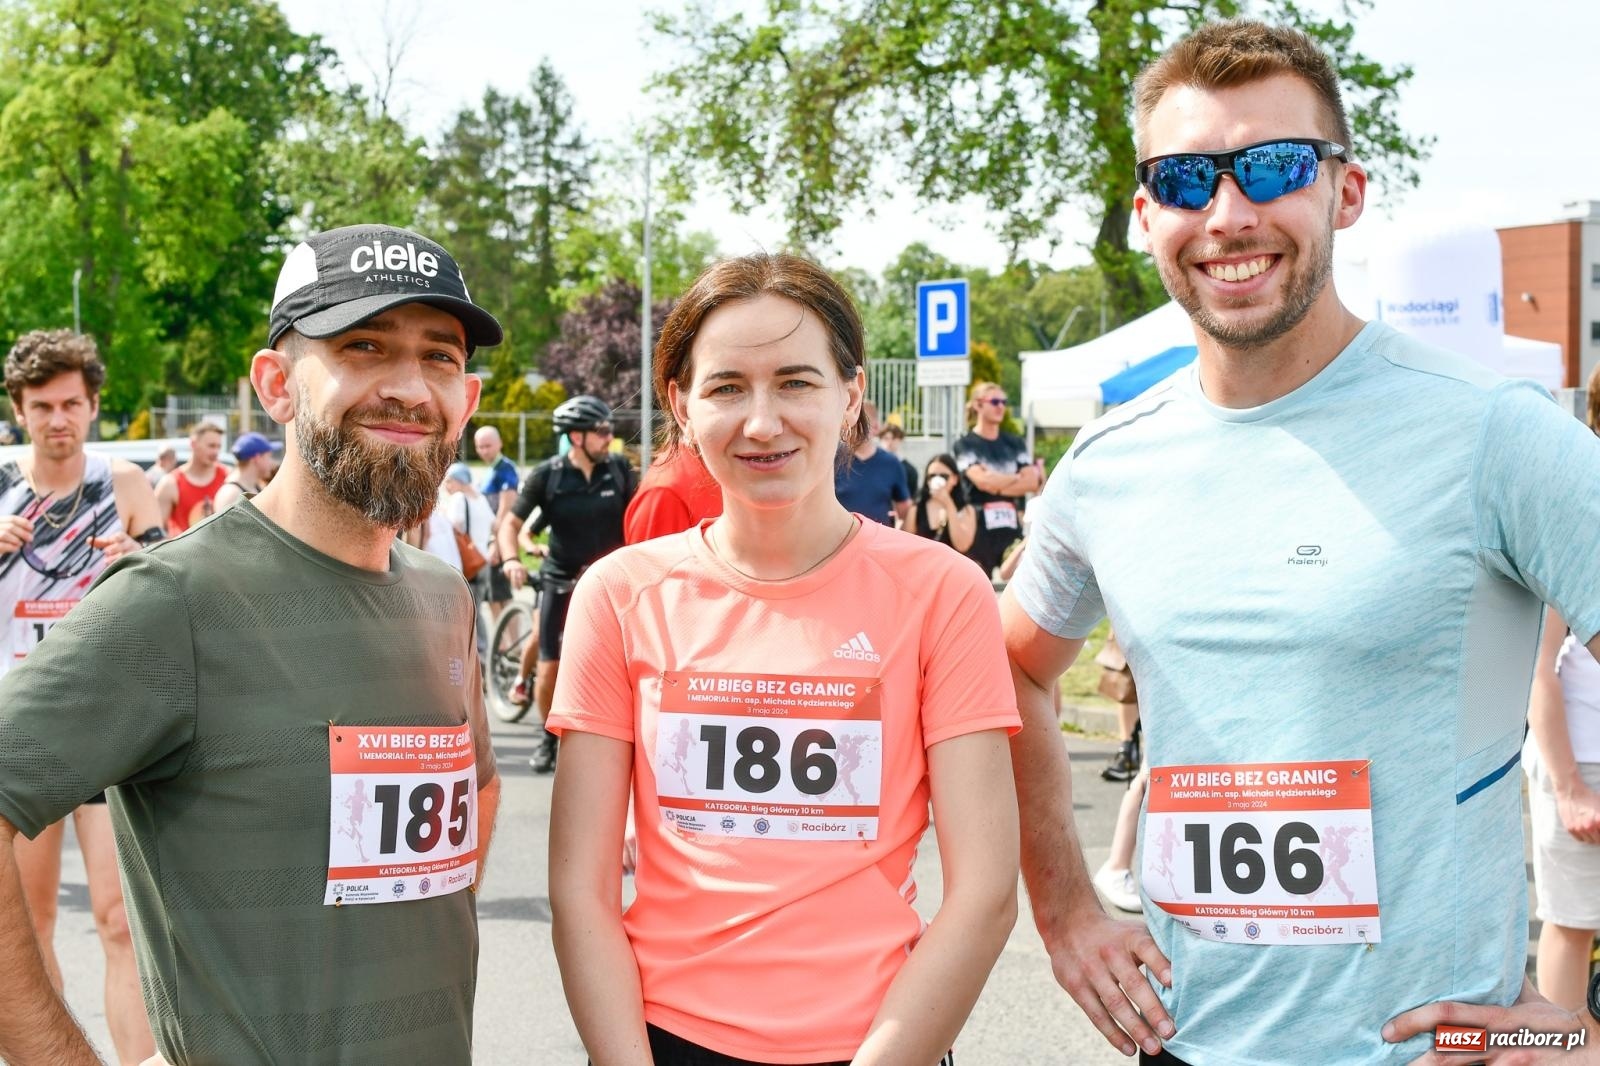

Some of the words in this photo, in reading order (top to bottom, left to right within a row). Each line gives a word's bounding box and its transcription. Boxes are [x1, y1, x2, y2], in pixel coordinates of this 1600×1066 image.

[350, 240, 439, 278] ciele
[365, 274, 431, 289] ATHLETICS
[927, 290, 957, 351] P
[1287, 557, 1328, 568] Kalenji
[833, 648, 880, 664] adidas
[688, 677, 715, 691] XVI
[718, 678, 753, 693] BIEG
[756, 680, 786, 694] BEZ
[789, 682, 856, 697] GRANIC
[691, 694, 730, 703] MEMORIAŁ
[731, 695, 744, 703] im.
[744, 697, 762, 706] asp.
[763, 697, 796, 706] Michała
[797, 698, 855, 709] Kędzierskiego
[752, 707, 770, 715] maja
[357, 734, 387, 749] XVI
[390, 734, 427, 749] BIEG
[429, 733, 454, 749] BEZ
[364, 752, 404, 760] MEMORIAŁ
[405, 751, 418, 760] im.
[418, 752, 434, 762] asp.
[700, 724, 837, 795] 186
[426, 762, 441, 771] maja
[1170, 773, 1195, 788] XVI
[1197, 772, 1232, 787] BIEG
[1234, 771, 1264, 786] BEZ
[1266, 769, 1338, 785] GRANIC
[1174, 791, 1210, 799] MEMORIAŁ
[1212, 790, 1223, 798] im.
[1224, 791, 1240, 799] asp.
[1242, 789, 1274, 797] Michała
[1276, 788, 1337, 798] Kędzierskiego
[705, 803, 750, 812] KATEGORIA:
[751, 805, 768, 814] Bieg
[770, 806, 800, 815] Główny
[810, 807, 824, 815] km
[1233, 801, 1250, 809] maja
[375, 779, 469, 854] 185
[801, 822, 847, 832] Racibórz
[1184, 821, 1325, 895] 166
[379, 867, 417, 876] KATEGORIA:
[418, 864, 431, 874] Bieg
[1195, 907, 1239, 915] KATEGORIA:
[1240, 907, 1257, 917] Bieg
[1258, 907, 1289, 918] Główny
[1300, 908, 1315, 916] km
[1292, 925, 1344, 936] Racibórz
